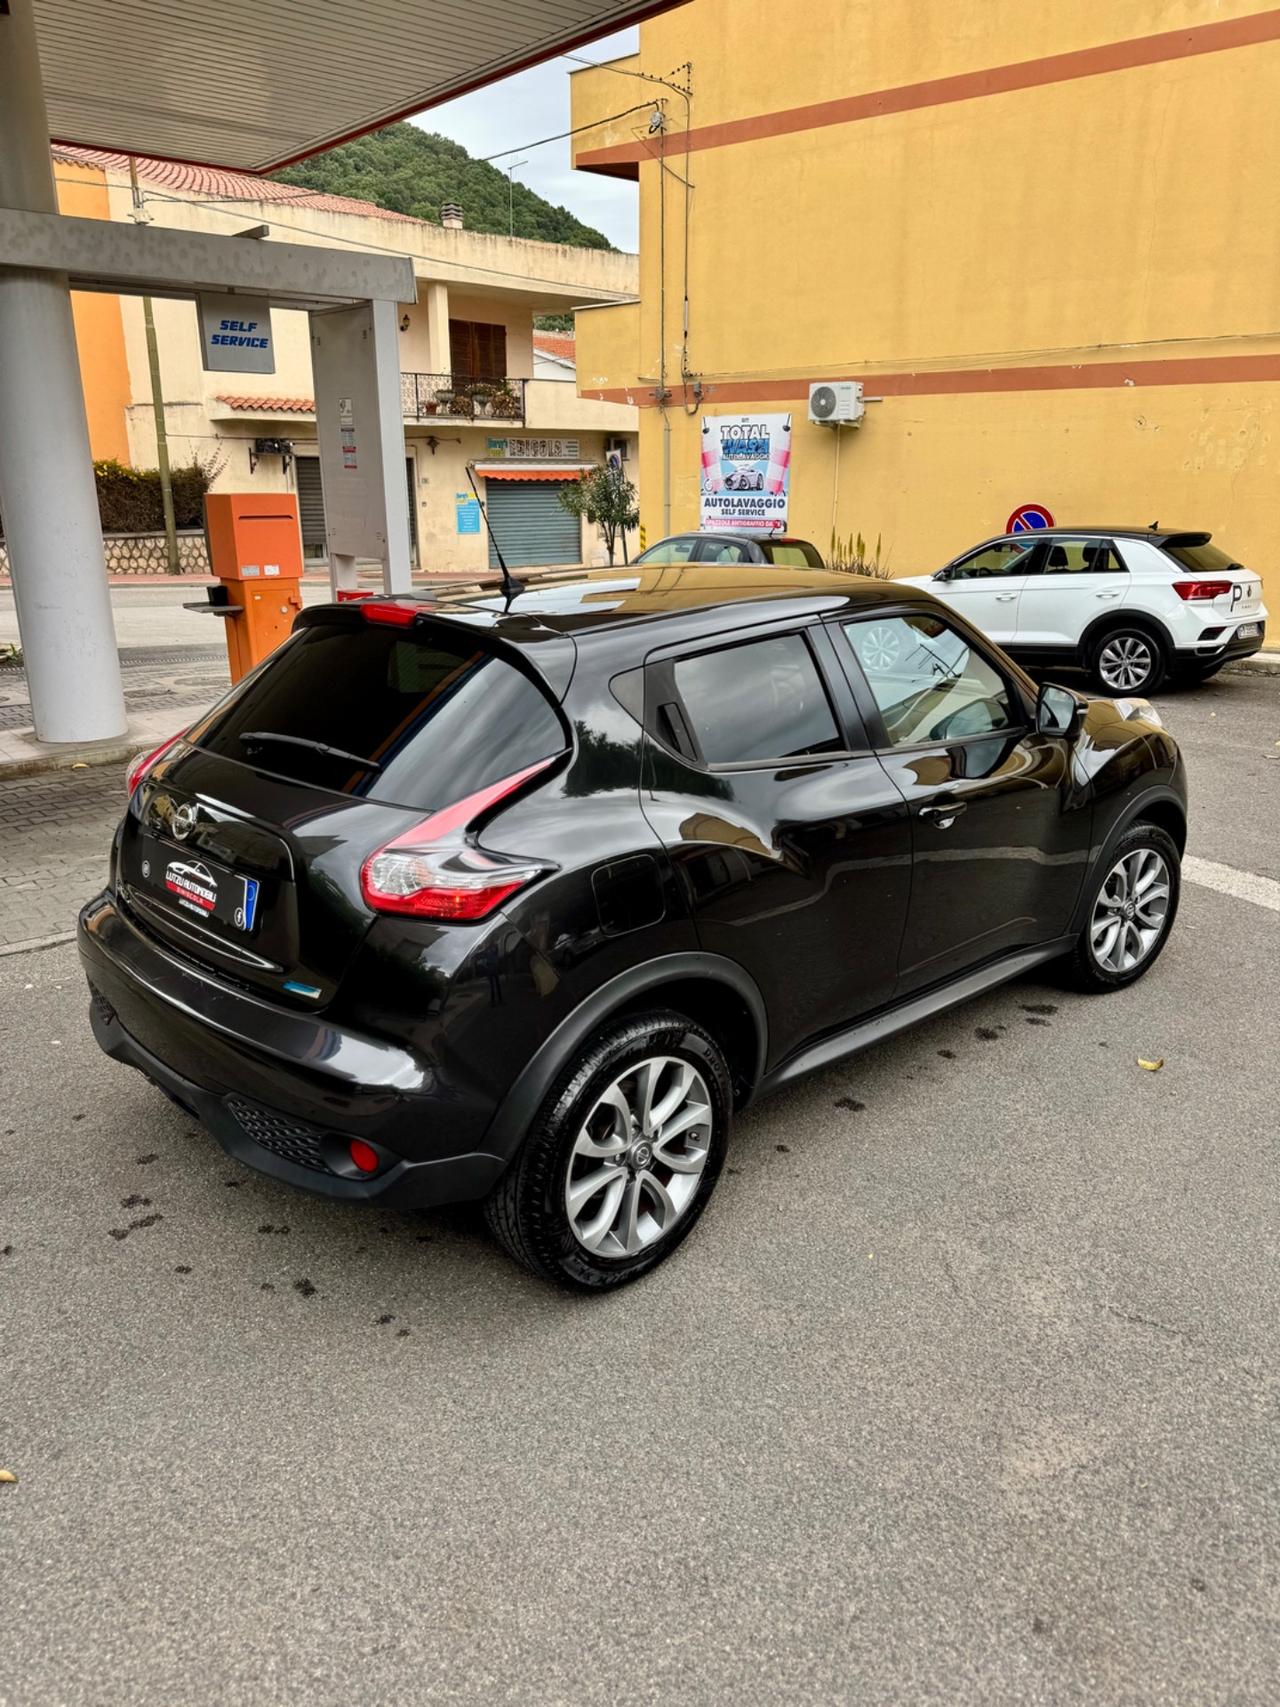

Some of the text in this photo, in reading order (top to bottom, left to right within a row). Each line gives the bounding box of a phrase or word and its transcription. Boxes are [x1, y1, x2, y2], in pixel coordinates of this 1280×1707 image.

[219, 320, 258, 332] SELF
[210, 334, 269, 348] SERVICE
[720, 424, 770, 440] TOTAL
[720, 439, 770, 454] WASH
[704, 498, 785, 508] AUTOLAVAGGIO
[738, 508, 765, 516] SERVICE
